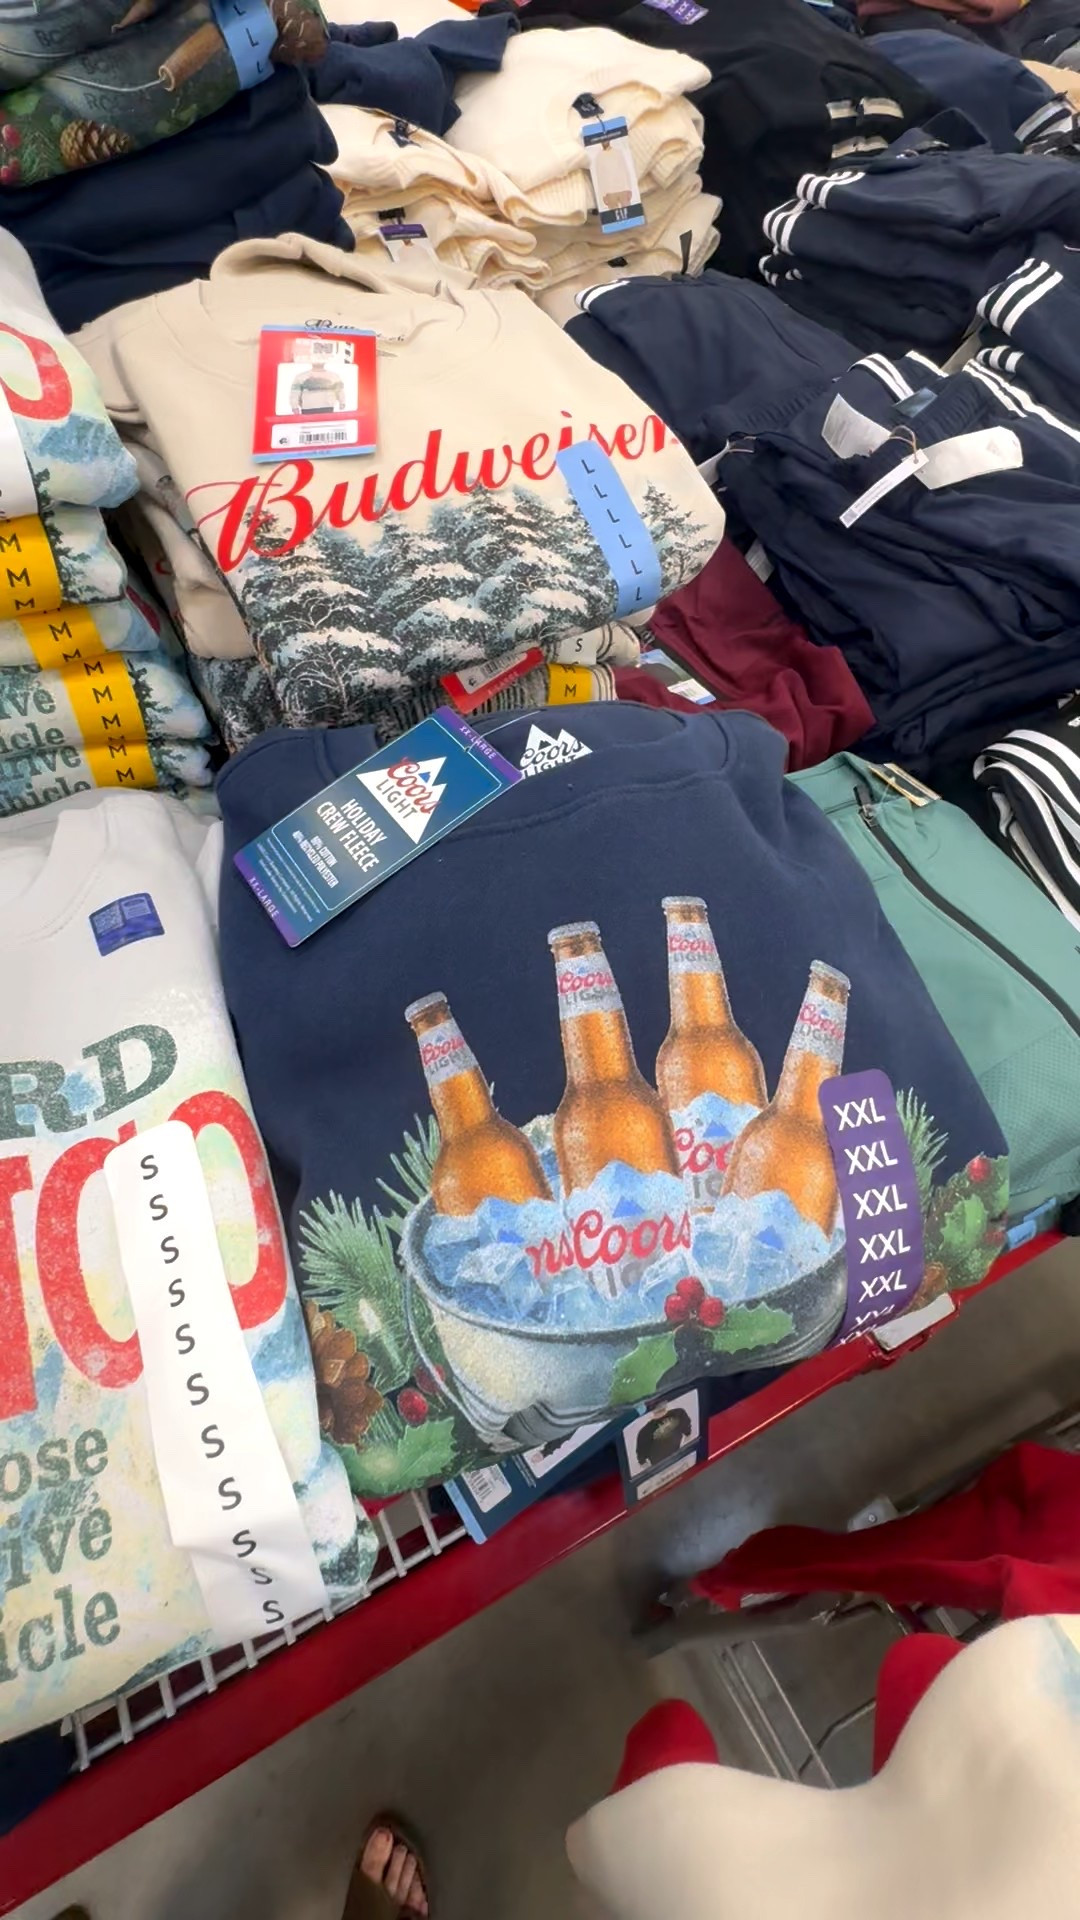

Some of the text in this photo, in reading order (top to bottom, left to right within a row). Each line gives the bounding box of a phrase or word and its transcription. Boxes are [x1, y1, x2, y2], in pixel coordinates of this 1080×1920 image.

[232, 4, 246, 16] L
[245, 28, 259, 47] L
[581, 459, 595, 474] L
[186, 411, 679, 573] Budweiser
[594, 484, 608, 499] L
[606, 509, 620, 523] L
[0, 533, 22, 552] M
[618, 534, 632, 549] L
[7, 568, 31, 587] M
[631, 560, 642, 574] L
[15, 598, 35, 610] M
[635, 587, 642, 601] L
[48, 621, 72, 642] M
[63, 649, 81, 662] M
[575, 638, 583, 652] S
[84, 661, 104, 676] M
[92, 685, 113, 704] M
[564, 684, 577, 697] M
[101, 713, 121, 729] M
[108, 744, 127, 758] M
[520, 739, 584, 768] Coors
[116, 767, 135, 782] M
[387, 757, 441, 814] Coors
[376, 779, 418, 819] LIGHT
[340, 798, 387, 846] HOLIDAY
[316, 801, 380, 873] CREW FLEECE
[319, 846, 338, 868] COTTON
[314, 860, 339, 889] POLYESTER
[558, 970, 613, 994] Coors
[0, 1024, 178, 1140] RD
[833, 1097, 886, 1131] XXL
[140, 1154, 159, 1180] S
[844, 1140, 898, 1175] XXL
[149, 1194, 168, 1221] S
[853, 1184, 907, 1220] XXL
[160, 1235, 179, 1264] S
[570, 1209, 691, 1269] Coors
[859, 1228, 911, 1264] XXL
[168, 1278, 185, 1307] S
[858, 1269, 907, 1303] XXL
[175, 1323, 195, 1355] S
[186, 1373, 210, 1406] S
[201, 1424, 225, 1458] S
[0, 1428, 109, 1502] ose
[218, 1477, 242, 1510] S
[232, 1529, 257, 1558] S
[250, 1567, 273, 1585] S
[262, 1600, 285, 1624] S
